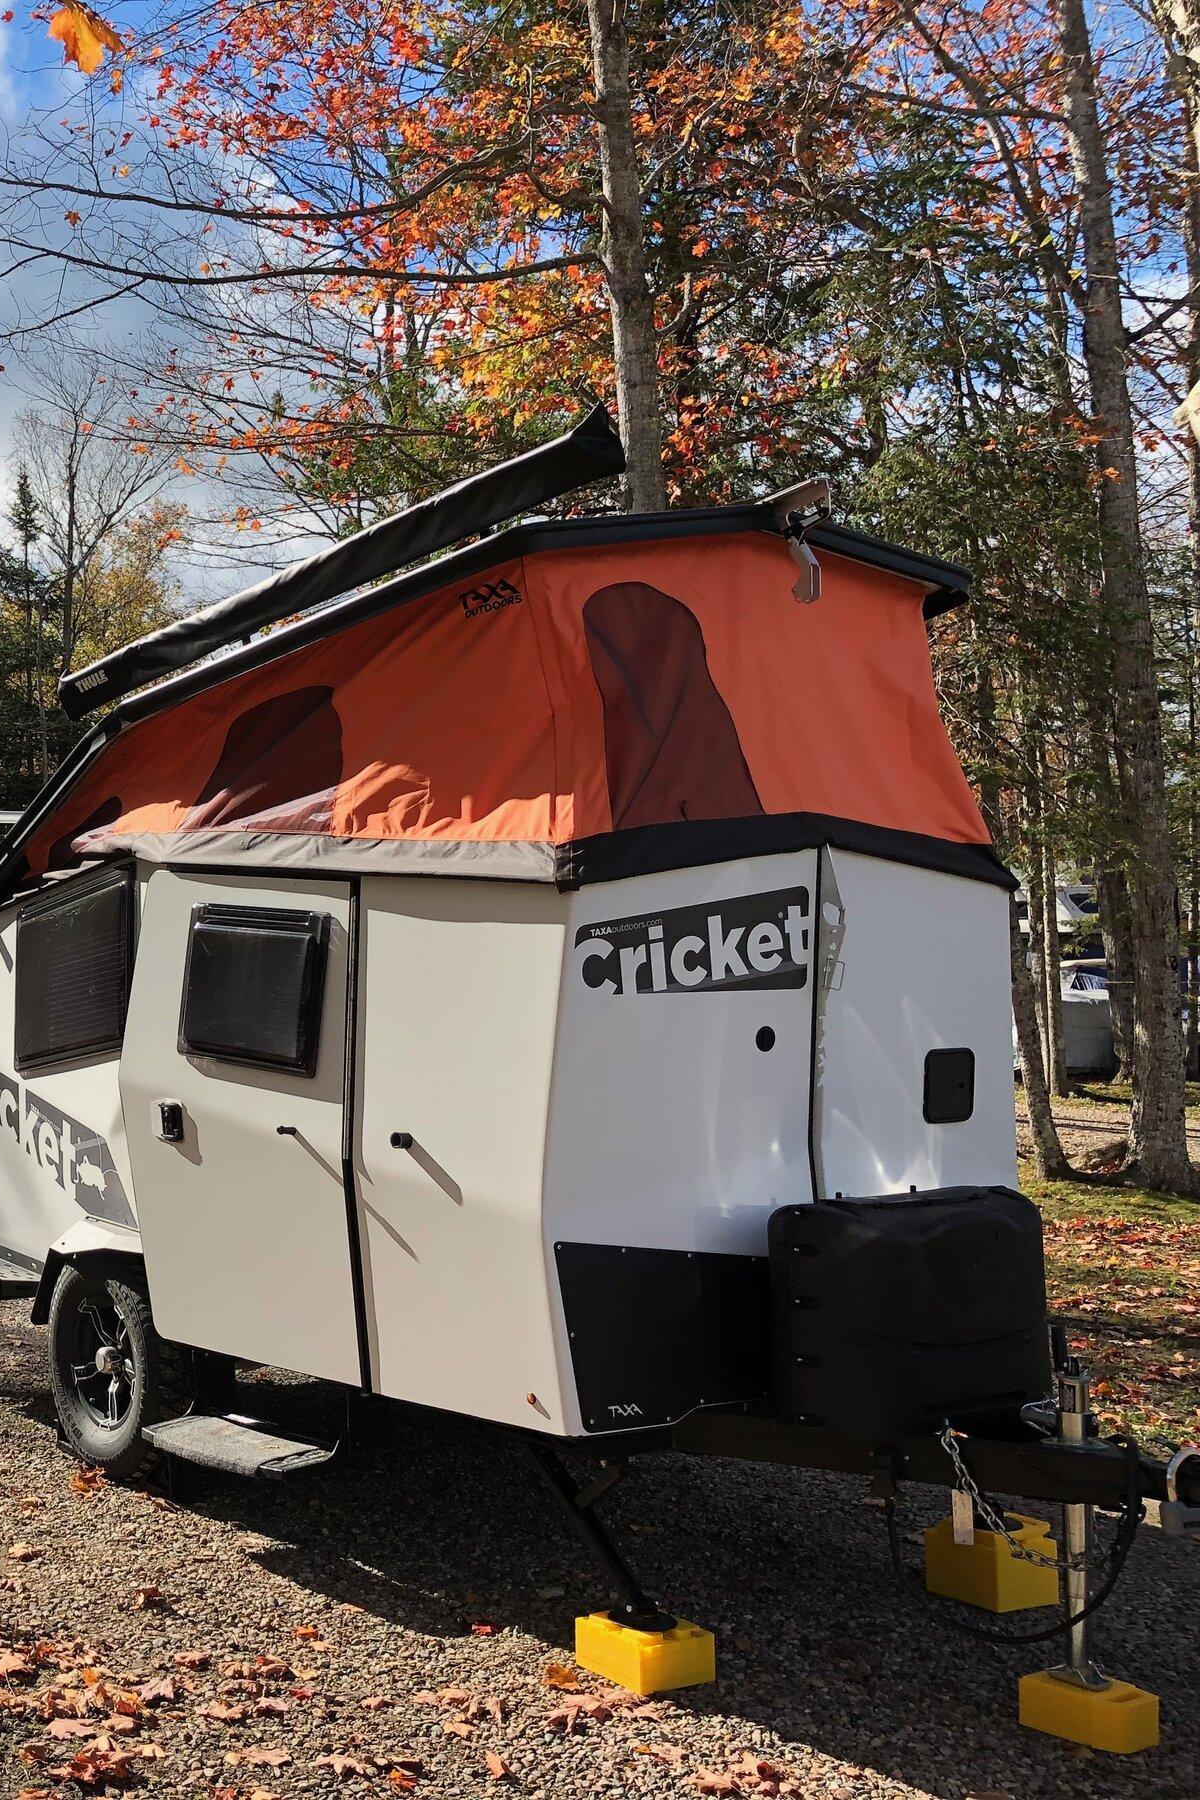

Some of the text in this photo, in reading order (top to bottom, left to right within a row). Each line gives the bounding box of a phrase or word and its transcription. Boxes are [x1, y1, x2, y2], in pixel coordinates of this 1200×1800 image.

[466, 594, 522, 618] OUTDOORS
[75, 670, 108, 693] THULE
[590, 918, 663, 937] TAXAoutdoors.com
[573, 905, 809, 996] Cricket
[608, 1403, 643, 1418] TAXA
